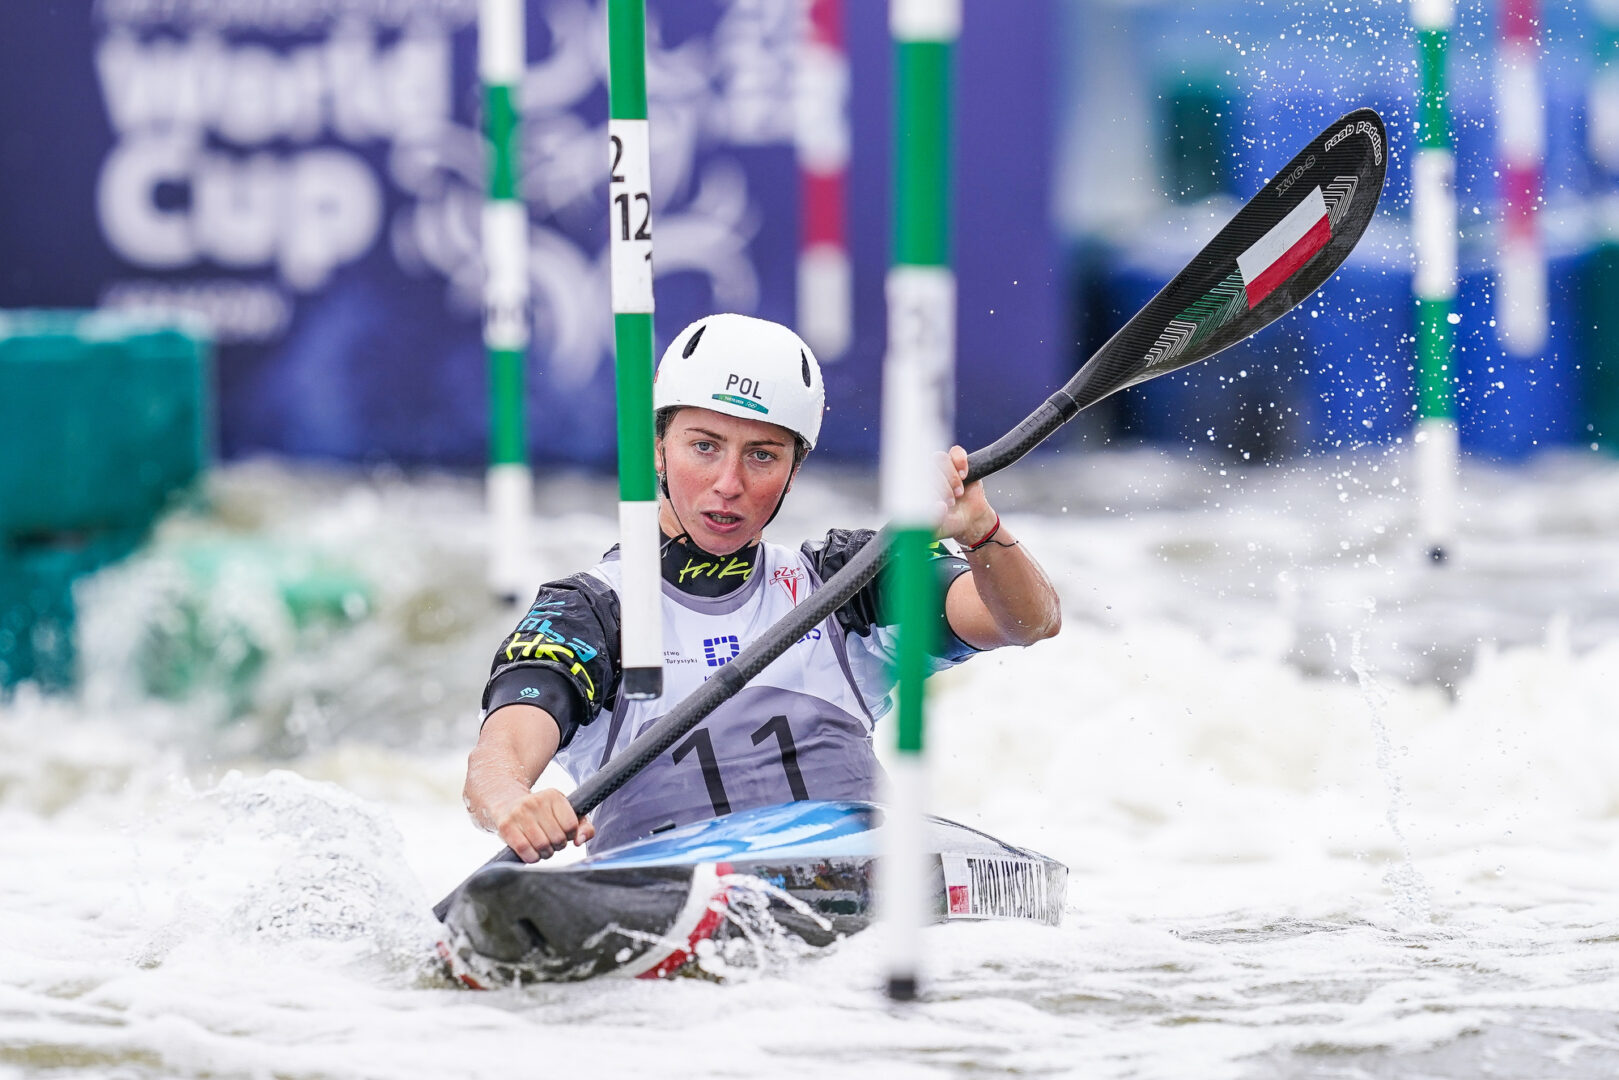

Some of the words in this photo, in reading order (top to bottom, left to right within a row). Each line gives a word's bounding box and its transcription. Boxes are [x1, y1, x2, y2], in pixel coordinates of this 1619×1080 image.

[1324, 124, 1355, 152] raab
[97, 140, 385, 290] Cup
[726, 373, 761, 400] POL
[671, 713, 810, 817] 11
